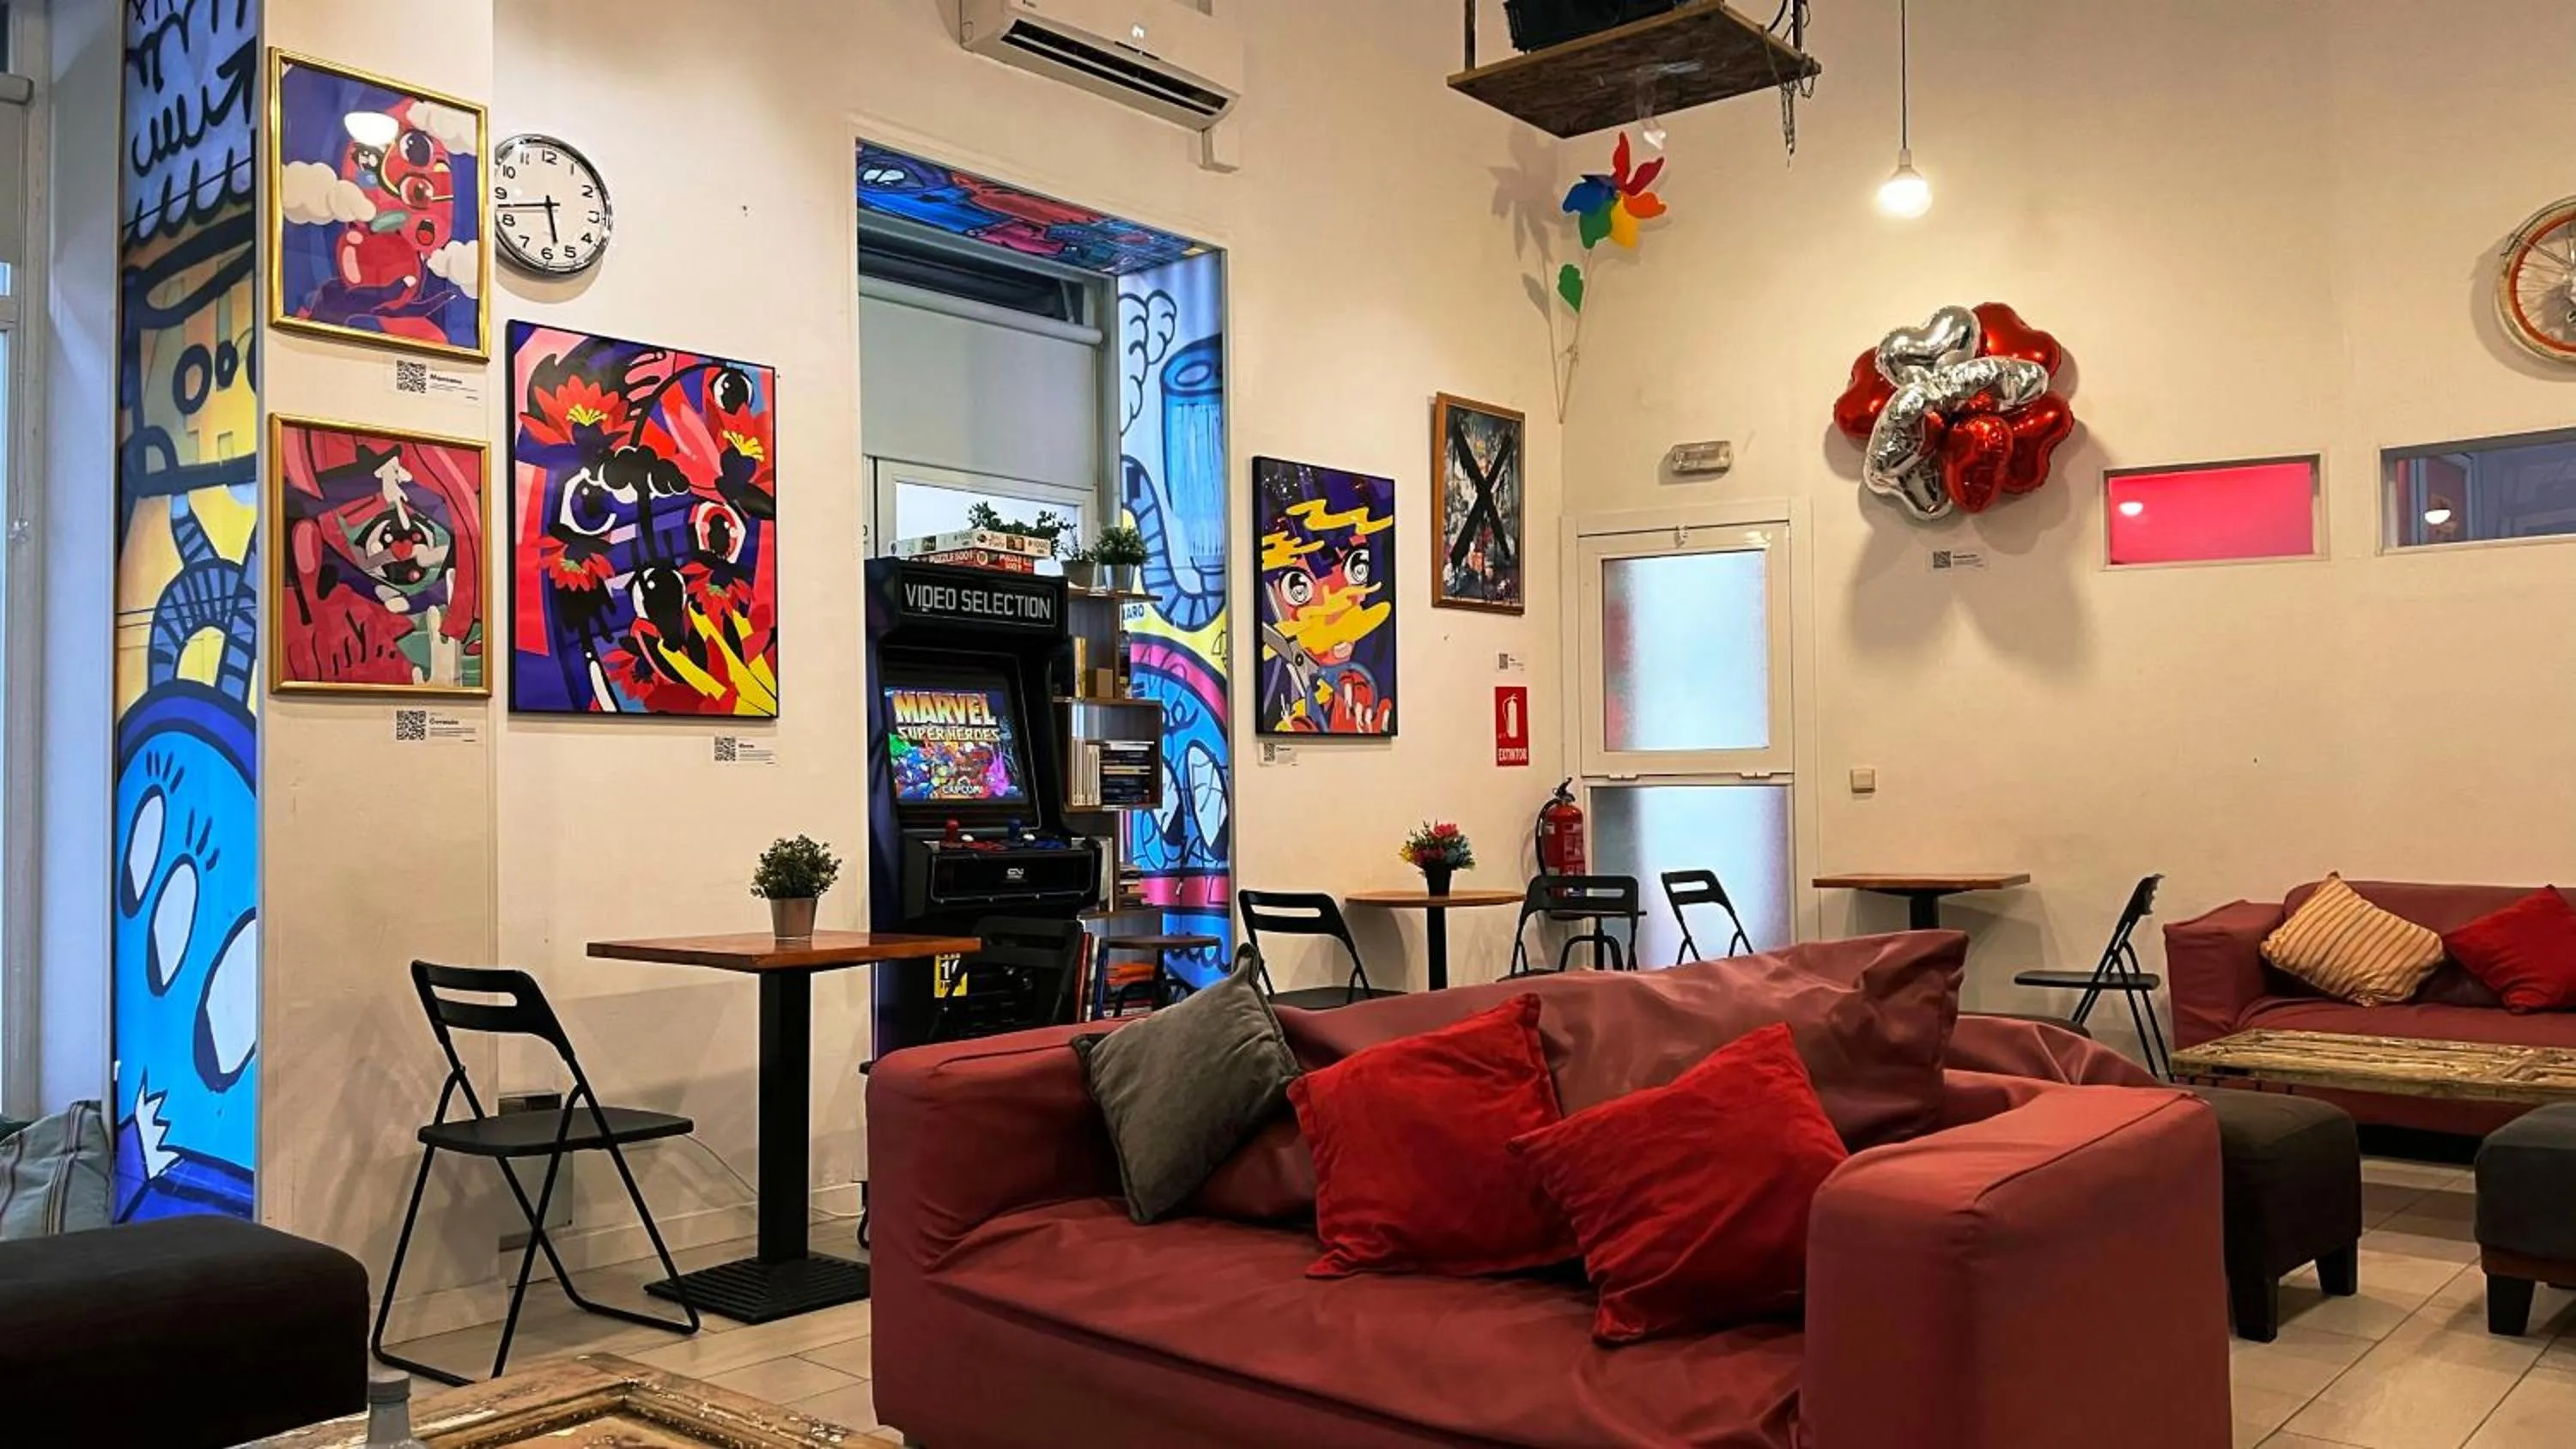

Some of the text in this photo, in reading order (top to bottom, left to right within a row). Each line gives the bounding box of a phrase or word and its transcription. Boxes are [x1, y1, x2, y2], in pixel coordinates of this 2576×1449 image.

[542, 150, 557, 165] 12
[502, 165, 516, 179] 10
[570, 163, 574, 175] 1
[495, 187, 507, 199] 9
[581, 185, 593, 197] 2
[501, 214, 516, 227] 8
[519, 234, 530, 248] 7
[580, 233, 593, 244] 4
[541, 247, 554, 260] 6
[564, 246, 577, 258] 5
[904, 582, 1051, 620] VIDEO SELECTION
[894, 690, 997, 725] MARVEL
[896, 726, 1001, 742] SUPER HEROES
